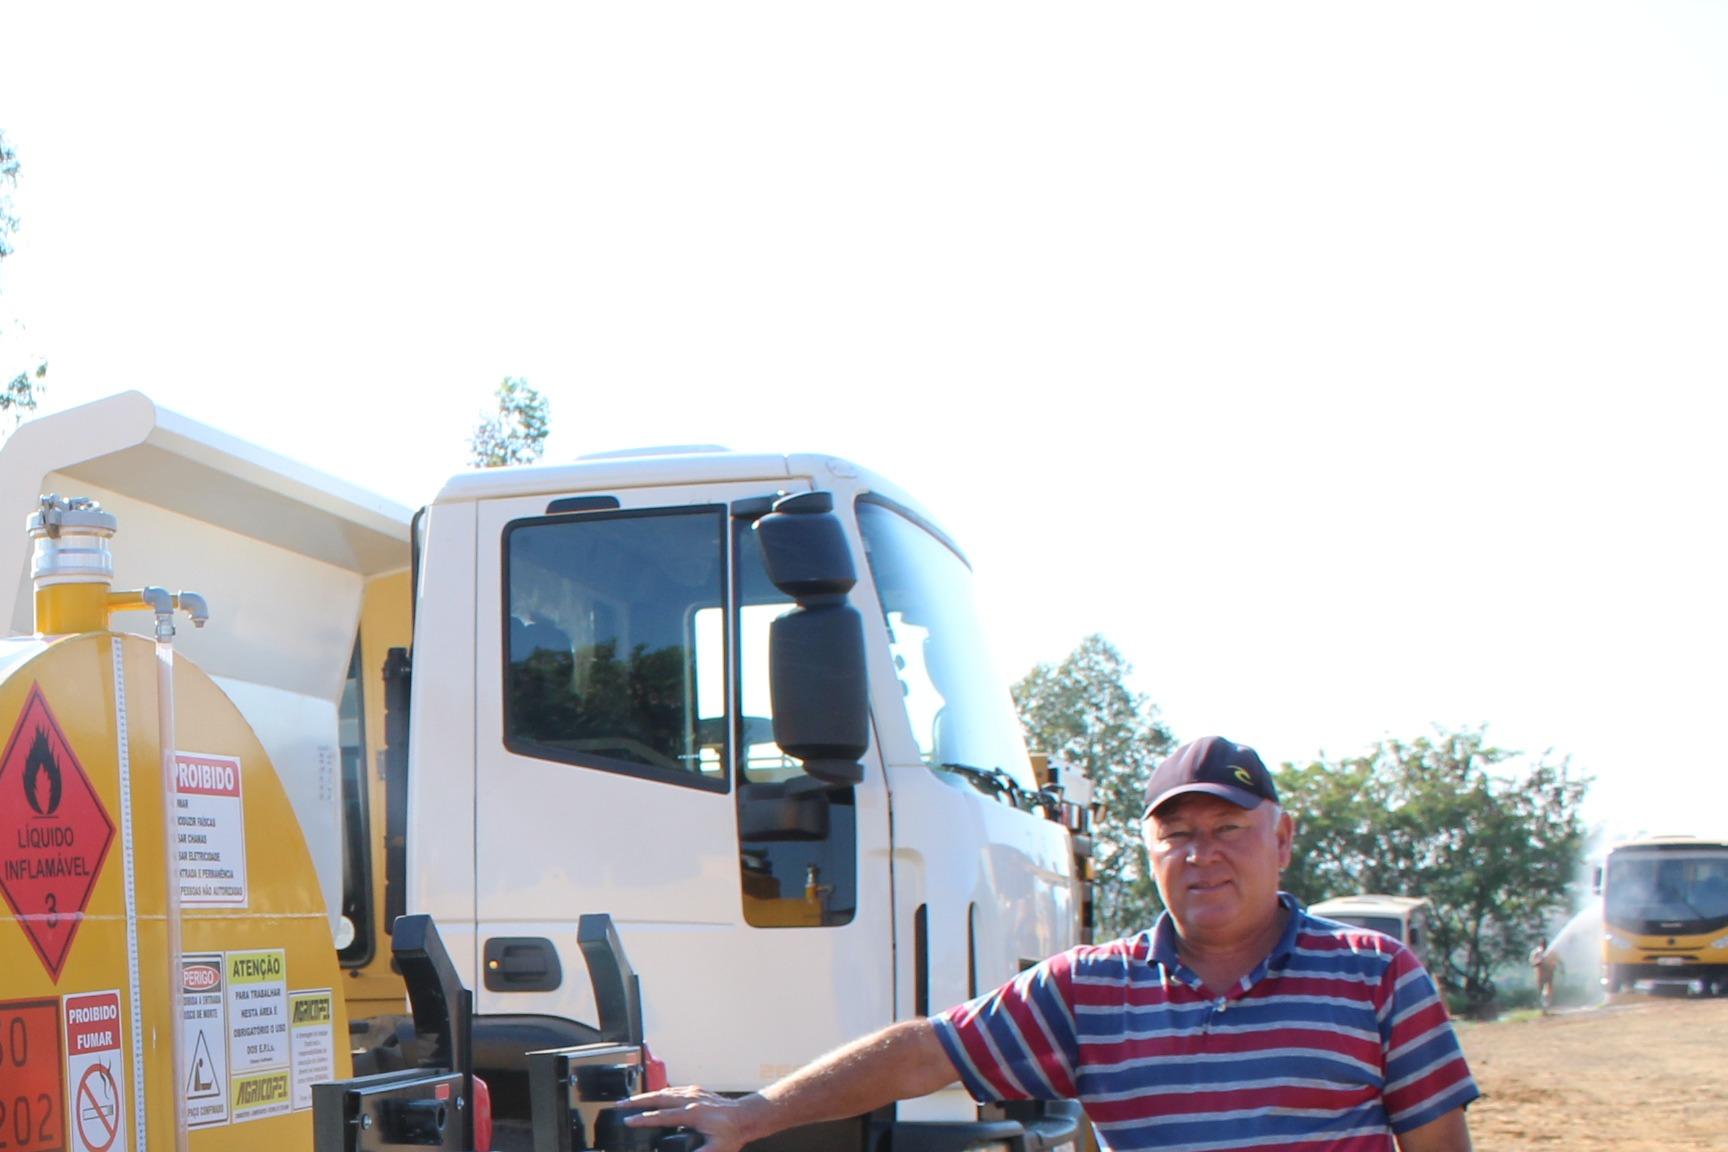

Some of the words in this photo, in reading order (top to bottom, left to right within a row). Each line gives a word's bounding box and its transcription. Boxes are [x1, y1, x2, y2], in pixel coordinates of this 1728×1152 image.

[18, 824, 74, 849] LÍQUIDO
[178, 834, 187, 844] SAR
[5, 851, 90, 882] INFLAMÁVEL
[44, 893, 58, 929] 3
[183, 970, 214, 985] PERIGO
[233, 955, 281, 980] ATENÇÃO
[235, 990, 250, 1000] PARA
[252, 988, 281, 999] TRABALHAR
[68, 1003, 117, 1025] PROIBIDO
[241, 1008, 258, 1018] NESTA
[77, 1031, 113, 1050] FUMAR
[236, 1075, 289, 1106] AGRICOPEL
